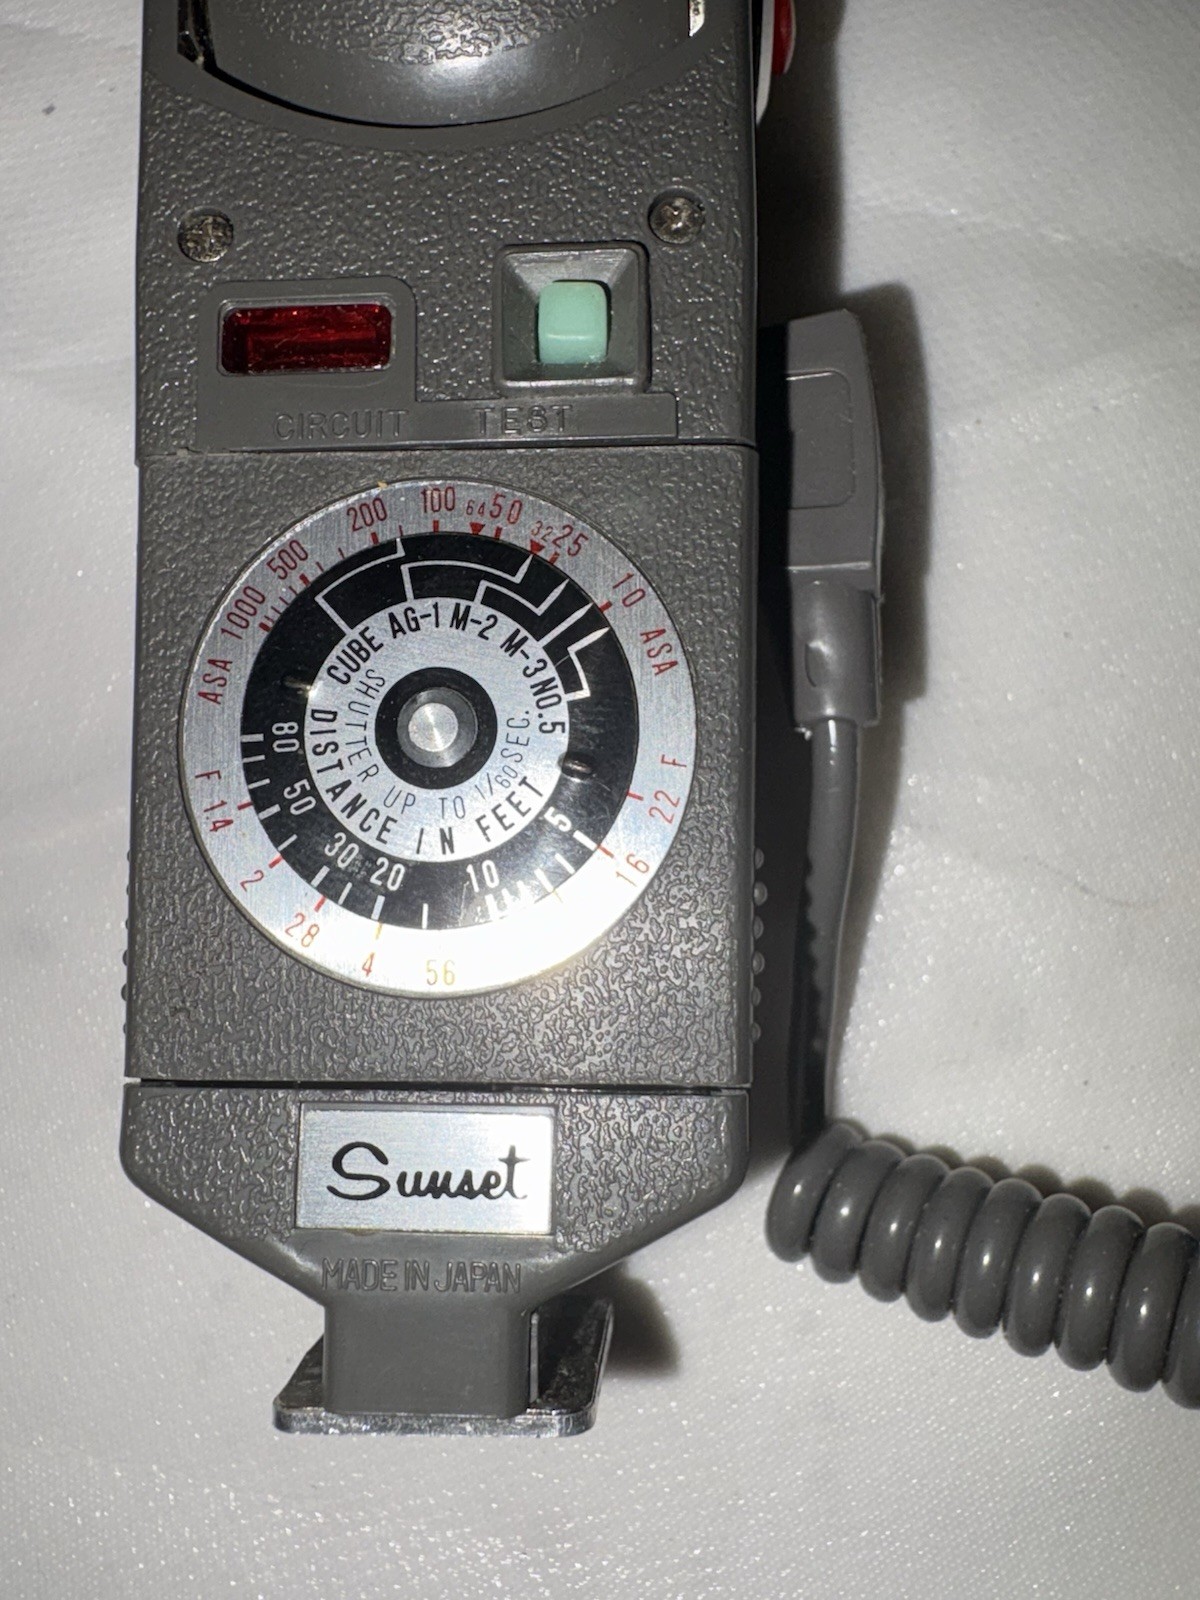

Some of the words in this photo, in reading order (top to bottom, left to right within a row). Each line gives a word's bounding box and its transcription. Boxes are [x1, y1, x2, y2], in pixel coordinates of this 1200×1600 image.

[273, 409, 408, 440] CIRCUIT
[473, 405, 573, 435] TEST
[466, 499, 486, 517] 64
[531, 520, 554, 542] 32
[198, 658, 233, 705] ASA
[220, 585, 266, 640] 1000
[267, 539, 309, 580] 500
[346, 497, 388, 532] 200
[421, 486, 456, 513] 100
[489, 492, 523, 525] 50
[552, 524, 589, 557] 25
[612, 572, 647, 608] 10
[640, 628, 679, 676] ASA
[326, 626, 384, 686] CUBE
[388, 602, 439, 639] AG-1
[450, 602, 498, 641] M-2
[500, 628, 548, 678] M-3
[271, 722, 300, 753] 80
[345, 669, 386, 782] SHUTTER
[383, 785, 416, 815] UP
[438, 795, 466, 820] TO
[195, 769, 222, 781] F
[661, 754, 687, 768] F
[283, 778, 317, 815] 50
[310, 708, 398, 845] DISTANCE
[416, 827, 455, 855] IN
[475, 776, 543, 843] FEET
[544, 806, 572, 833] 5
[649, 790, 680, 824] 22
[324, 832, 360, 868] 30
[240, 869, 265, 893] 2
[370, 857, 406, 892] 20
[466, 859, 500, 893] 10
[615, 852, 650, 888] 16
[361, 952, 375, 977] 4
[326, 1141, 531, 1200] Sunset
[321, 1257, 398, 1292] MADE
[404, 1260, 430, 1291] IN
[434, 1262, 521, 1293] JAPAN
